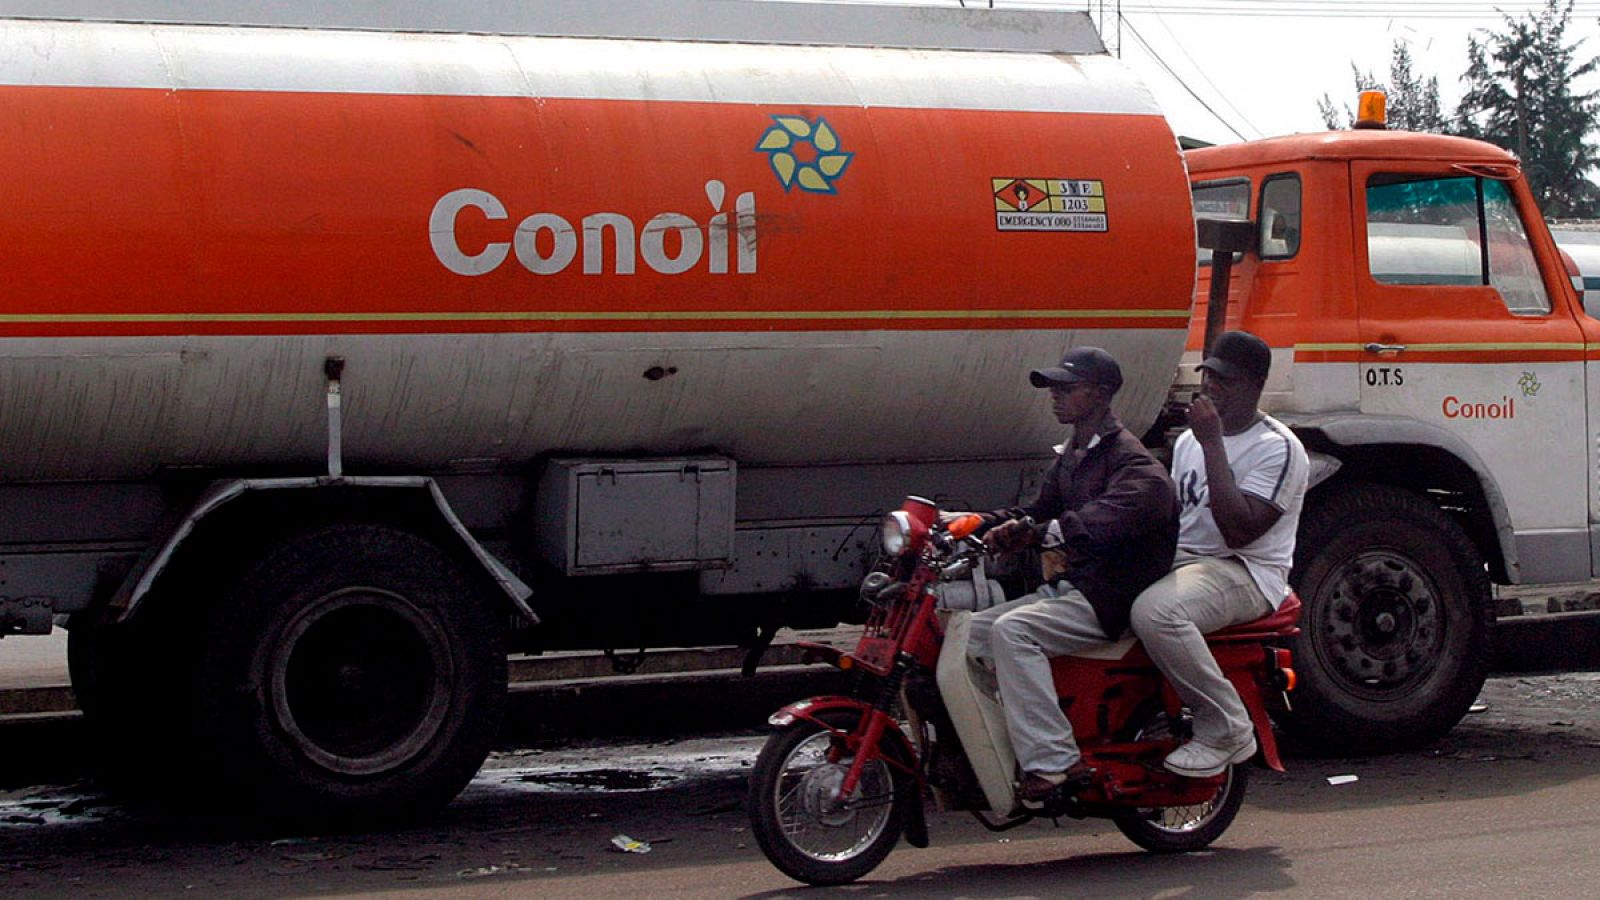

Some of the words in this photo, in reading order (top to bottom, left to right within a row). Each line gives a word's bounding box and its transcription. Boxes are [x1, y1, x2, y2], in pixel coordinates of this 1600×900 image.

[1061, 199, 1089, 210] 1203
[429, 180, 757, 276] Conoil
[999, 216, 1053, 226] EMERGENCY
[1442, 396, 1515, 419] Conoil
